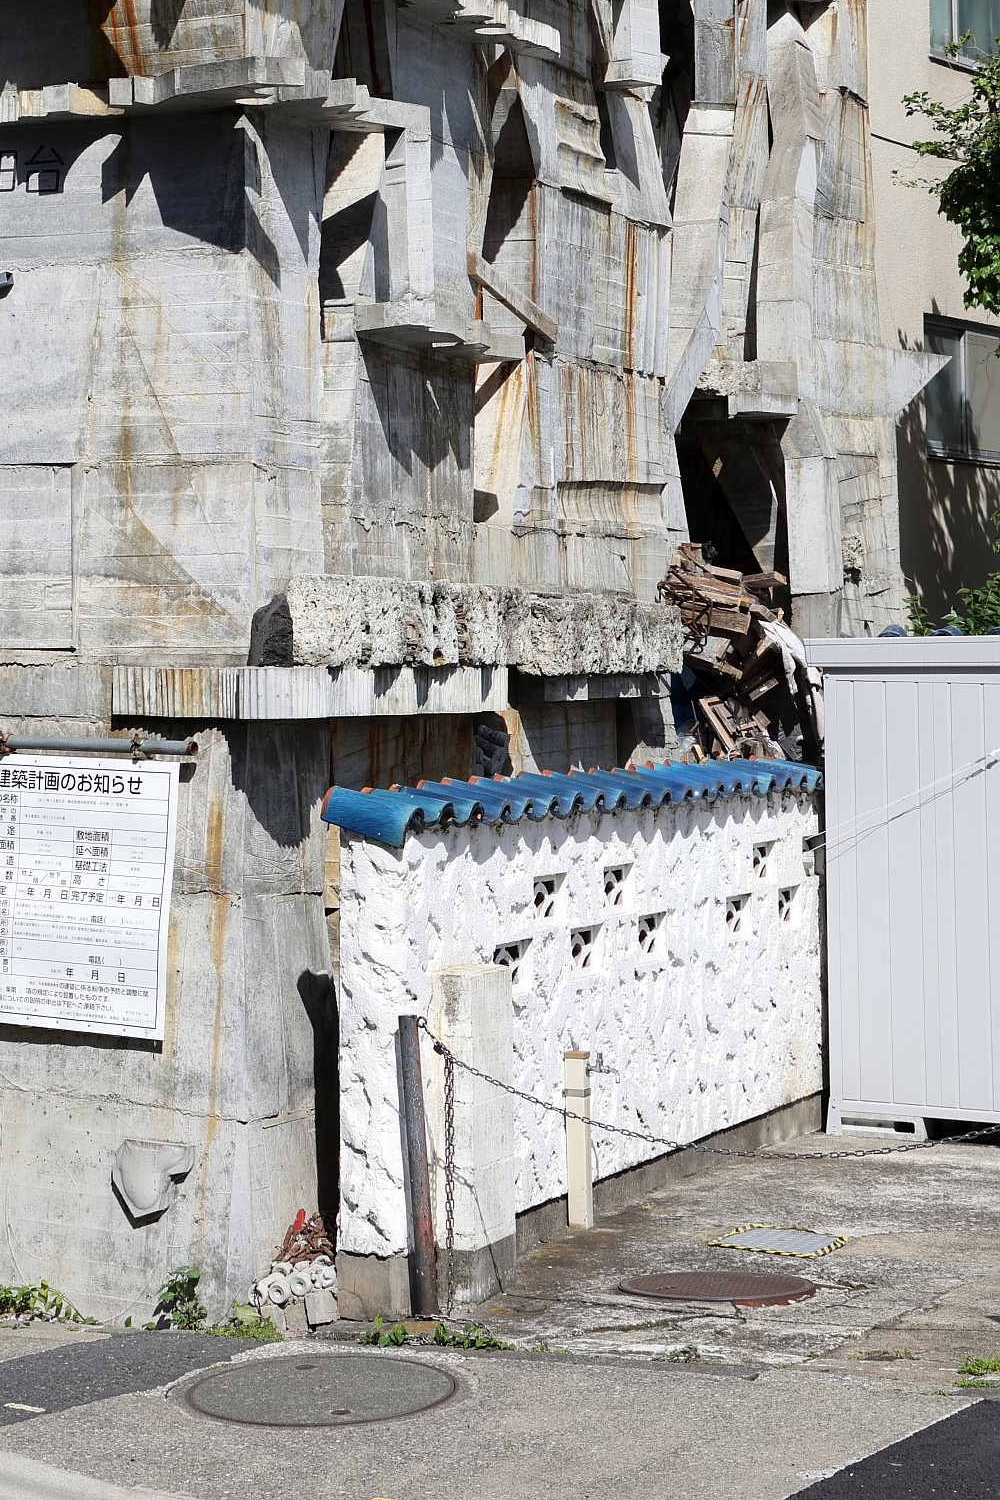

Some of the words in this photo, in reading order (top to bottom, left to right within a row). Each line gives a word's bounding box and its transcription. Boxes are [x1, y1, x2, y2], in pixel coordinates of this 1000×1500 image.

[76, 830, 110, 843] 敷地面積
[75, 845, 109, 858] 延べ面積
[74, 860, 108, 873] 基礎工法
[70, 890, 105, 903] 完了予定
